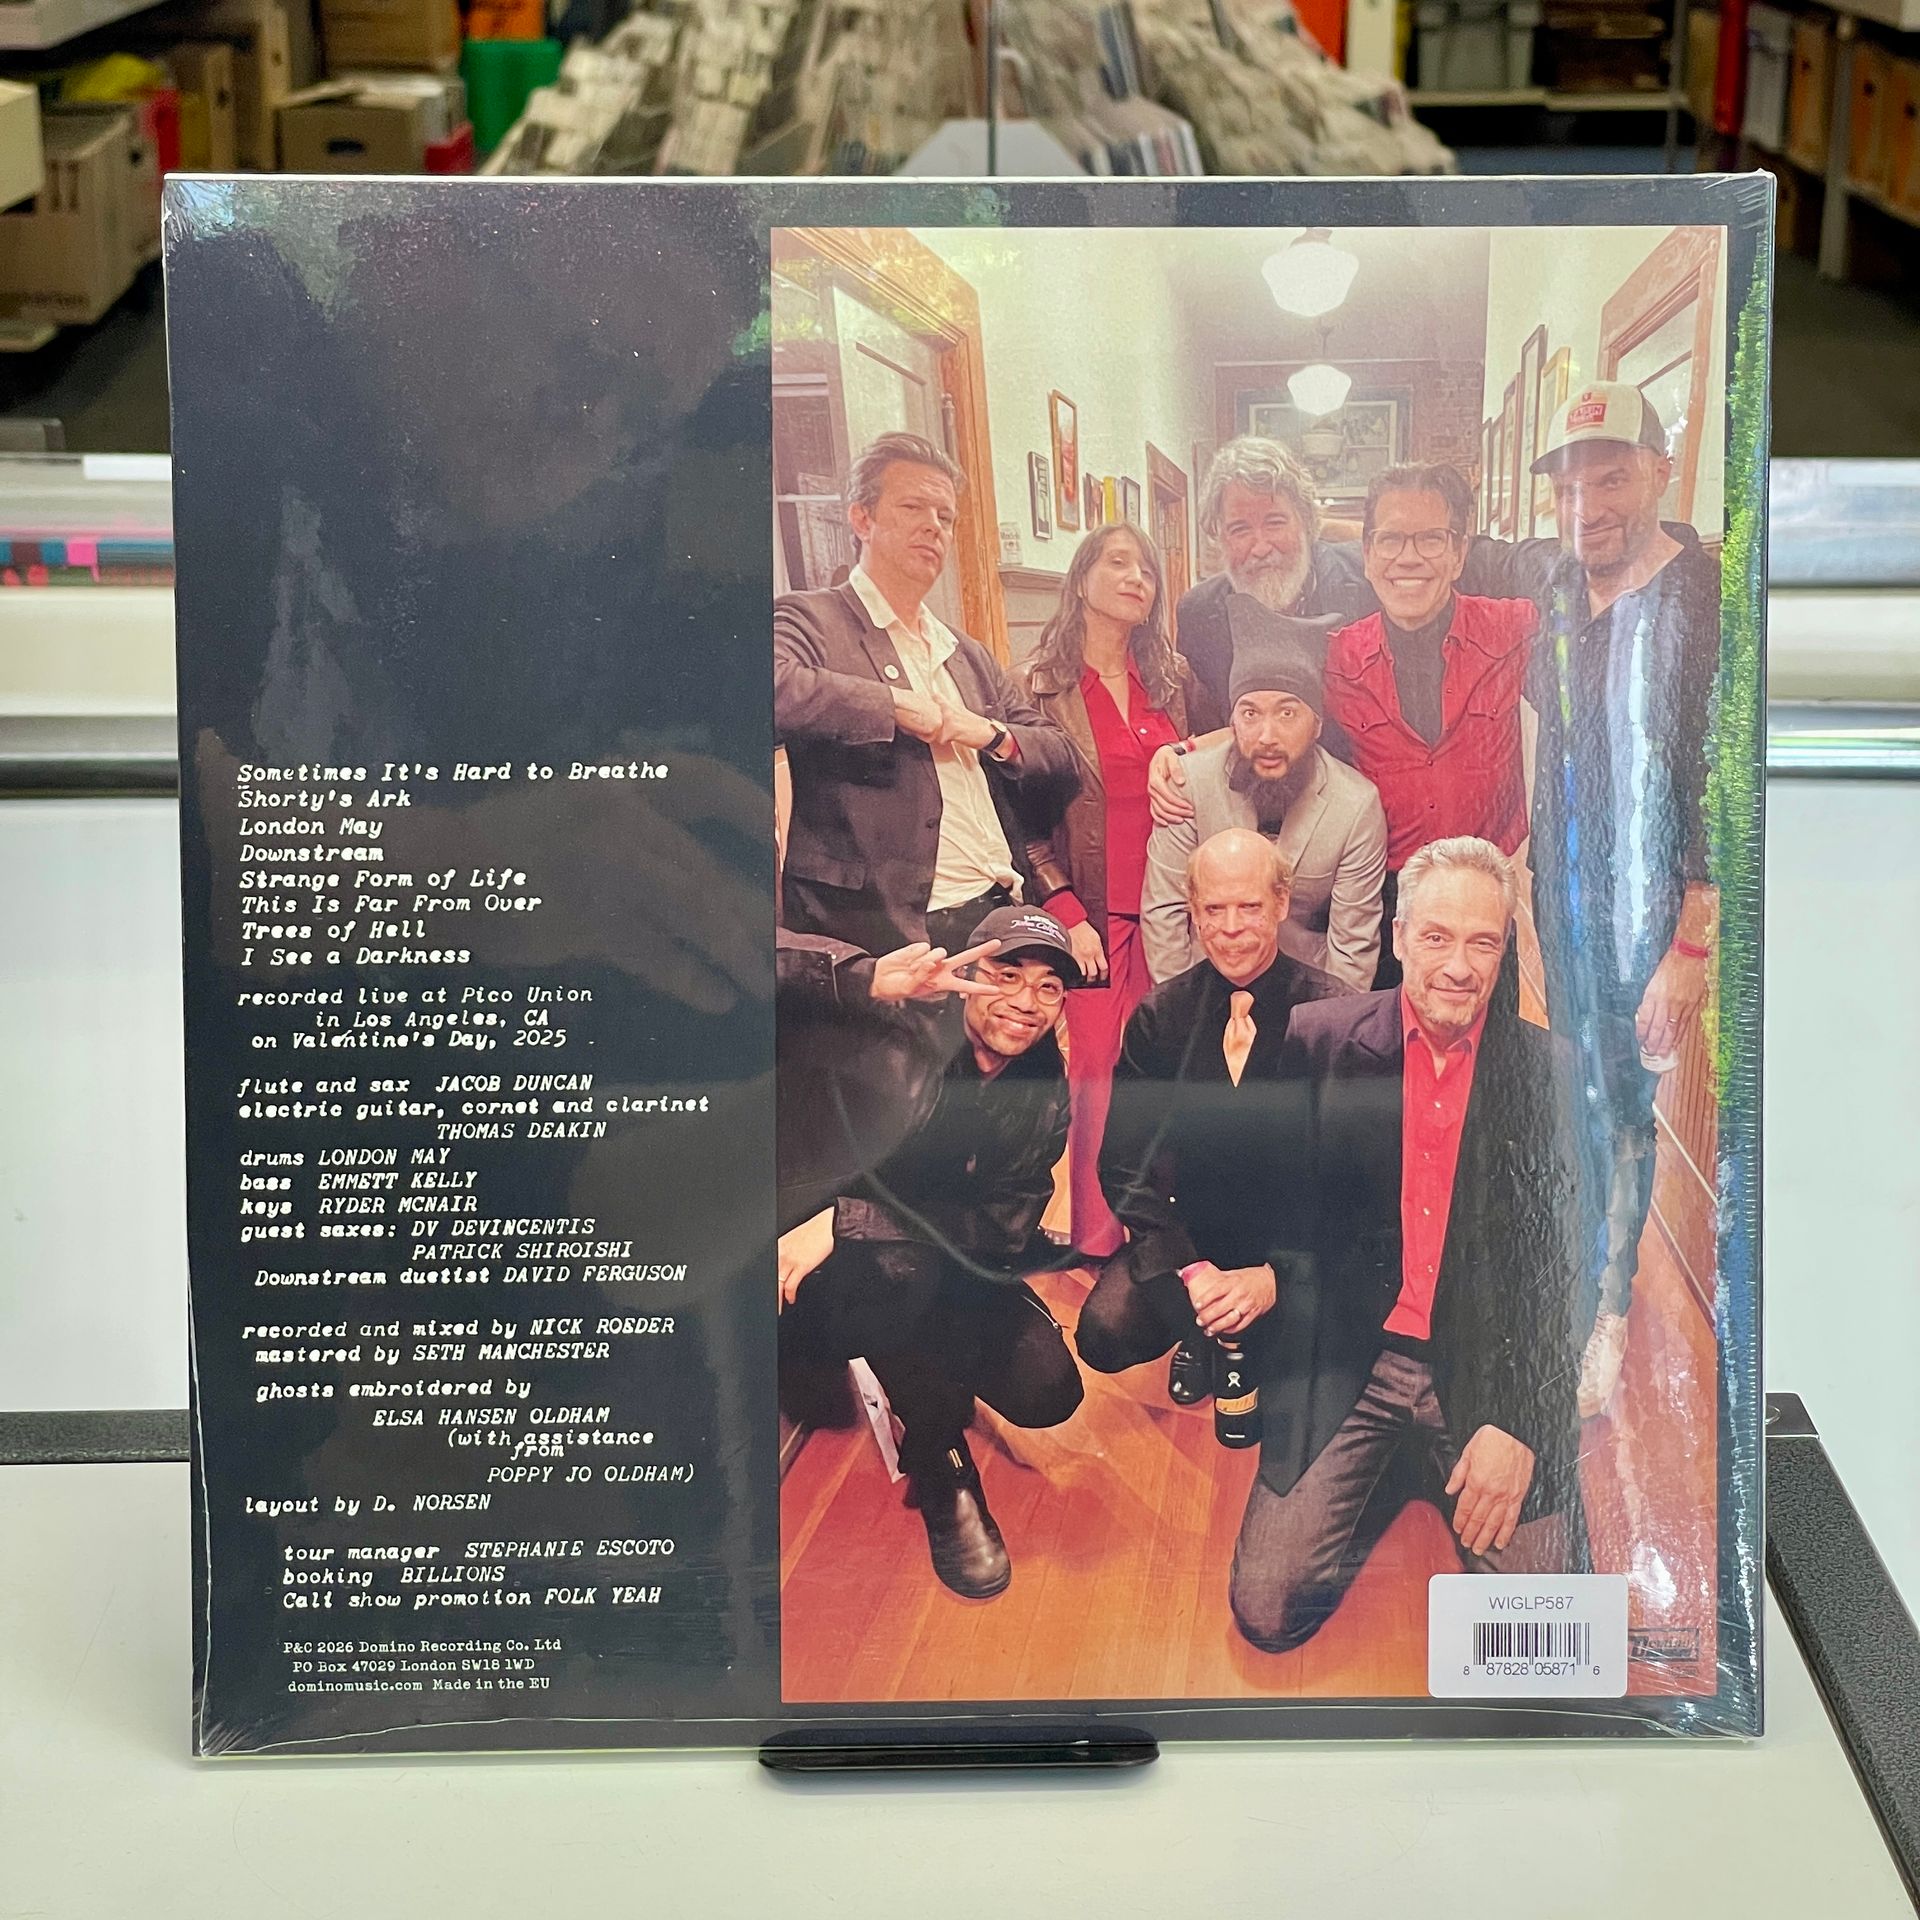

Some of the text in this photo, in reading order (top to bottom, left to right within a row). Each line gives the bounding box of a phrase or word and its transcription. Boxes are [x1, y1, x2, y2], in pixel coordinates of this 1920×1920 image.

[237, 762, 668, 782] Sometimes It's Hard to Breathe
[238, 789, 411, 811] Shorty's Ark
[239, 817, 382, 839] London May
[240, 844, 383, 861] Downstream
[239, 868, 526, 892] Strange Form of Life
[242, 894, 541, 914] This Is Far From Over
[242, 920, 425, 942] Trees of Hell
[241, 947, 470, 966] I See a Darkness
[238, 986, 592, 1006] recorded live at Pico Union
[316, 1009, 548, 1030] in Los Angeles, CA
[252, 1036, 276, 1048] on
[448, 1031, 496, 1051] Day,
[513, 1029, 566, 1047] 2025
[237, 1074, 593, 1098] flute and sax JACOB DUNCAN
[239, 1096, 708, 1120] electric guitar, cornet and clarinet
[438, 1122, 606, 1140] THOMAS DEAKIN
[240, 1148, 450, 1166] drums LONDON MAY
[240, 1171, 477, 1191] bass EMMETT KELLY
[240, 1196, 477, 1218] keys RYDER MCNAIR
[241, 1218, 595, 1243] guest saxes: DV DEVINCENTIS
[412, 1241, 633, 1260] PATRICK SHIROISHI
[255, 1265, 687, 1286] Downstream duetist DAVID FERGUSON
[242, 1317, 674, 1339] recorded and mixed by NICK ROEDER
[255, 1342, 609, 1365] mastered by SETH MANCHESTER
[256, 1379, 531, 1403] ghosts embroidered by
[372, 1407, 610, 1426] ELSA HANSEN OLDHAM
[448, 1428, 653, 1447] (with assistance
[510, 1441, 564, 1461] from
[487, 1464, 693, 1483] POPPY JO OLDHAM)
[246, 1494, 491, 1517] layout by D. NORSEN
[284, 1539, 674, 1563] tour manager STEPHANIE ESCOTO
[283, 1566, 505, 1587] booking BILLIONS
[348, 1592, 401, 1607] show
[414, 1589, 531, 1610] promotion
[544, 1588, 597, 1604] FOLK
[612, 1587, 661, 1604] YEAH
[1489, 1596, 1574, 1610] WIGLP587
[283, 1639, 561, 1653] P&C 2026 Domino Recording Co. Ltd
[293, 1659, 534, 1672] PO Box 47029 London SW18 1WD
[1463, 1662, 1600, 1676] 8 87828 05871 6
[288, 1678, 549, 1692] dominomusic.com Made in the EU
